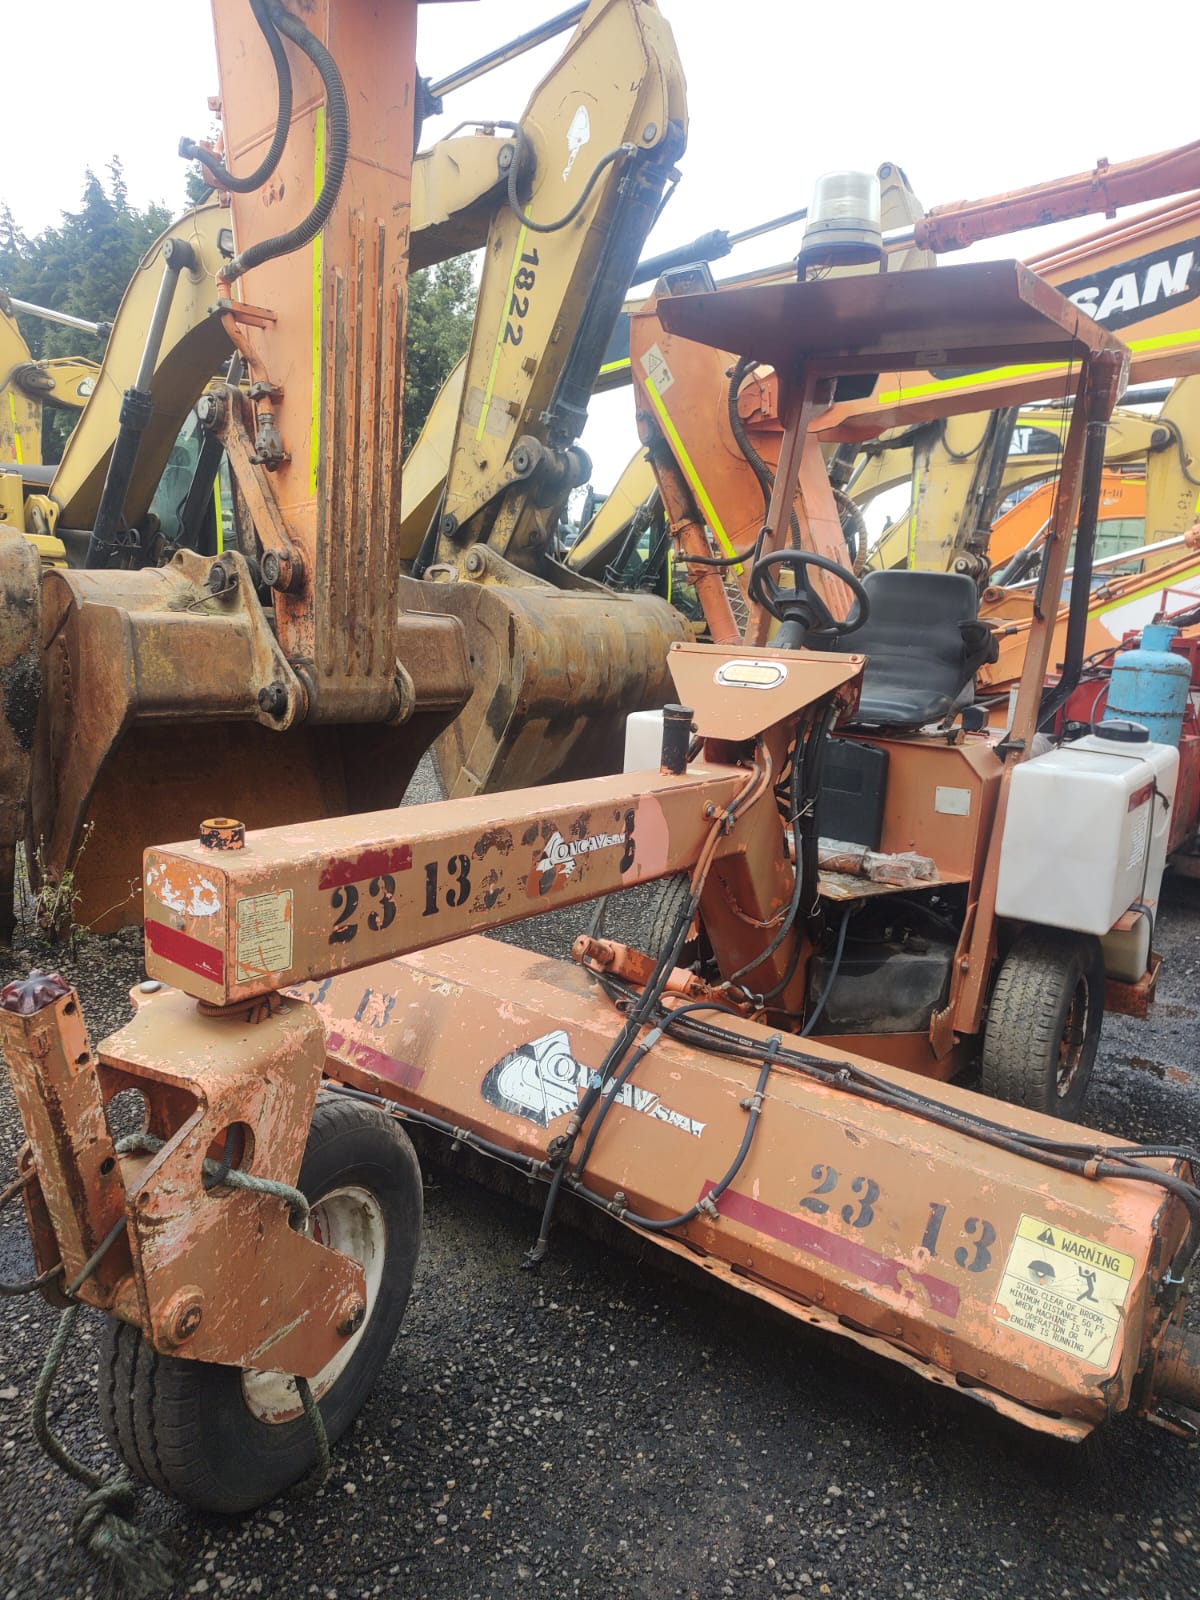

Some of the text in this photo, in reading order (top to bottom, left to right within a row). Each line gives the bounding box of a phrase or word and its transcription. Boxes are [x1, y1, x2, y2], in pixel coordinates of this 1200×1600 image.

[503, 248, 539, 346] 1822
[328, 874, 397, 945] 23
[422, 854, 471, 917] 13
[799, 1163, 997, 1273] 23 13
[1061, 1237, 1121, 1272] WARNING
[1009, 1288, 1040, 1308] MINIMUM
[1042, 1302, 1078, 1322] DISTANCE
[1081, 1318, 1092, 1328] 50
[1015, 1299, 1094, 1338] WHEN MACHINE IS IN
[1016, 1282, 1105, 1326] STAND CLEAR OF BROOM.
[1010, 1314, 1085, 1352] ENGINE IS RUNNING
[1025, 1312, 1079, 1340] OPERATION OR
